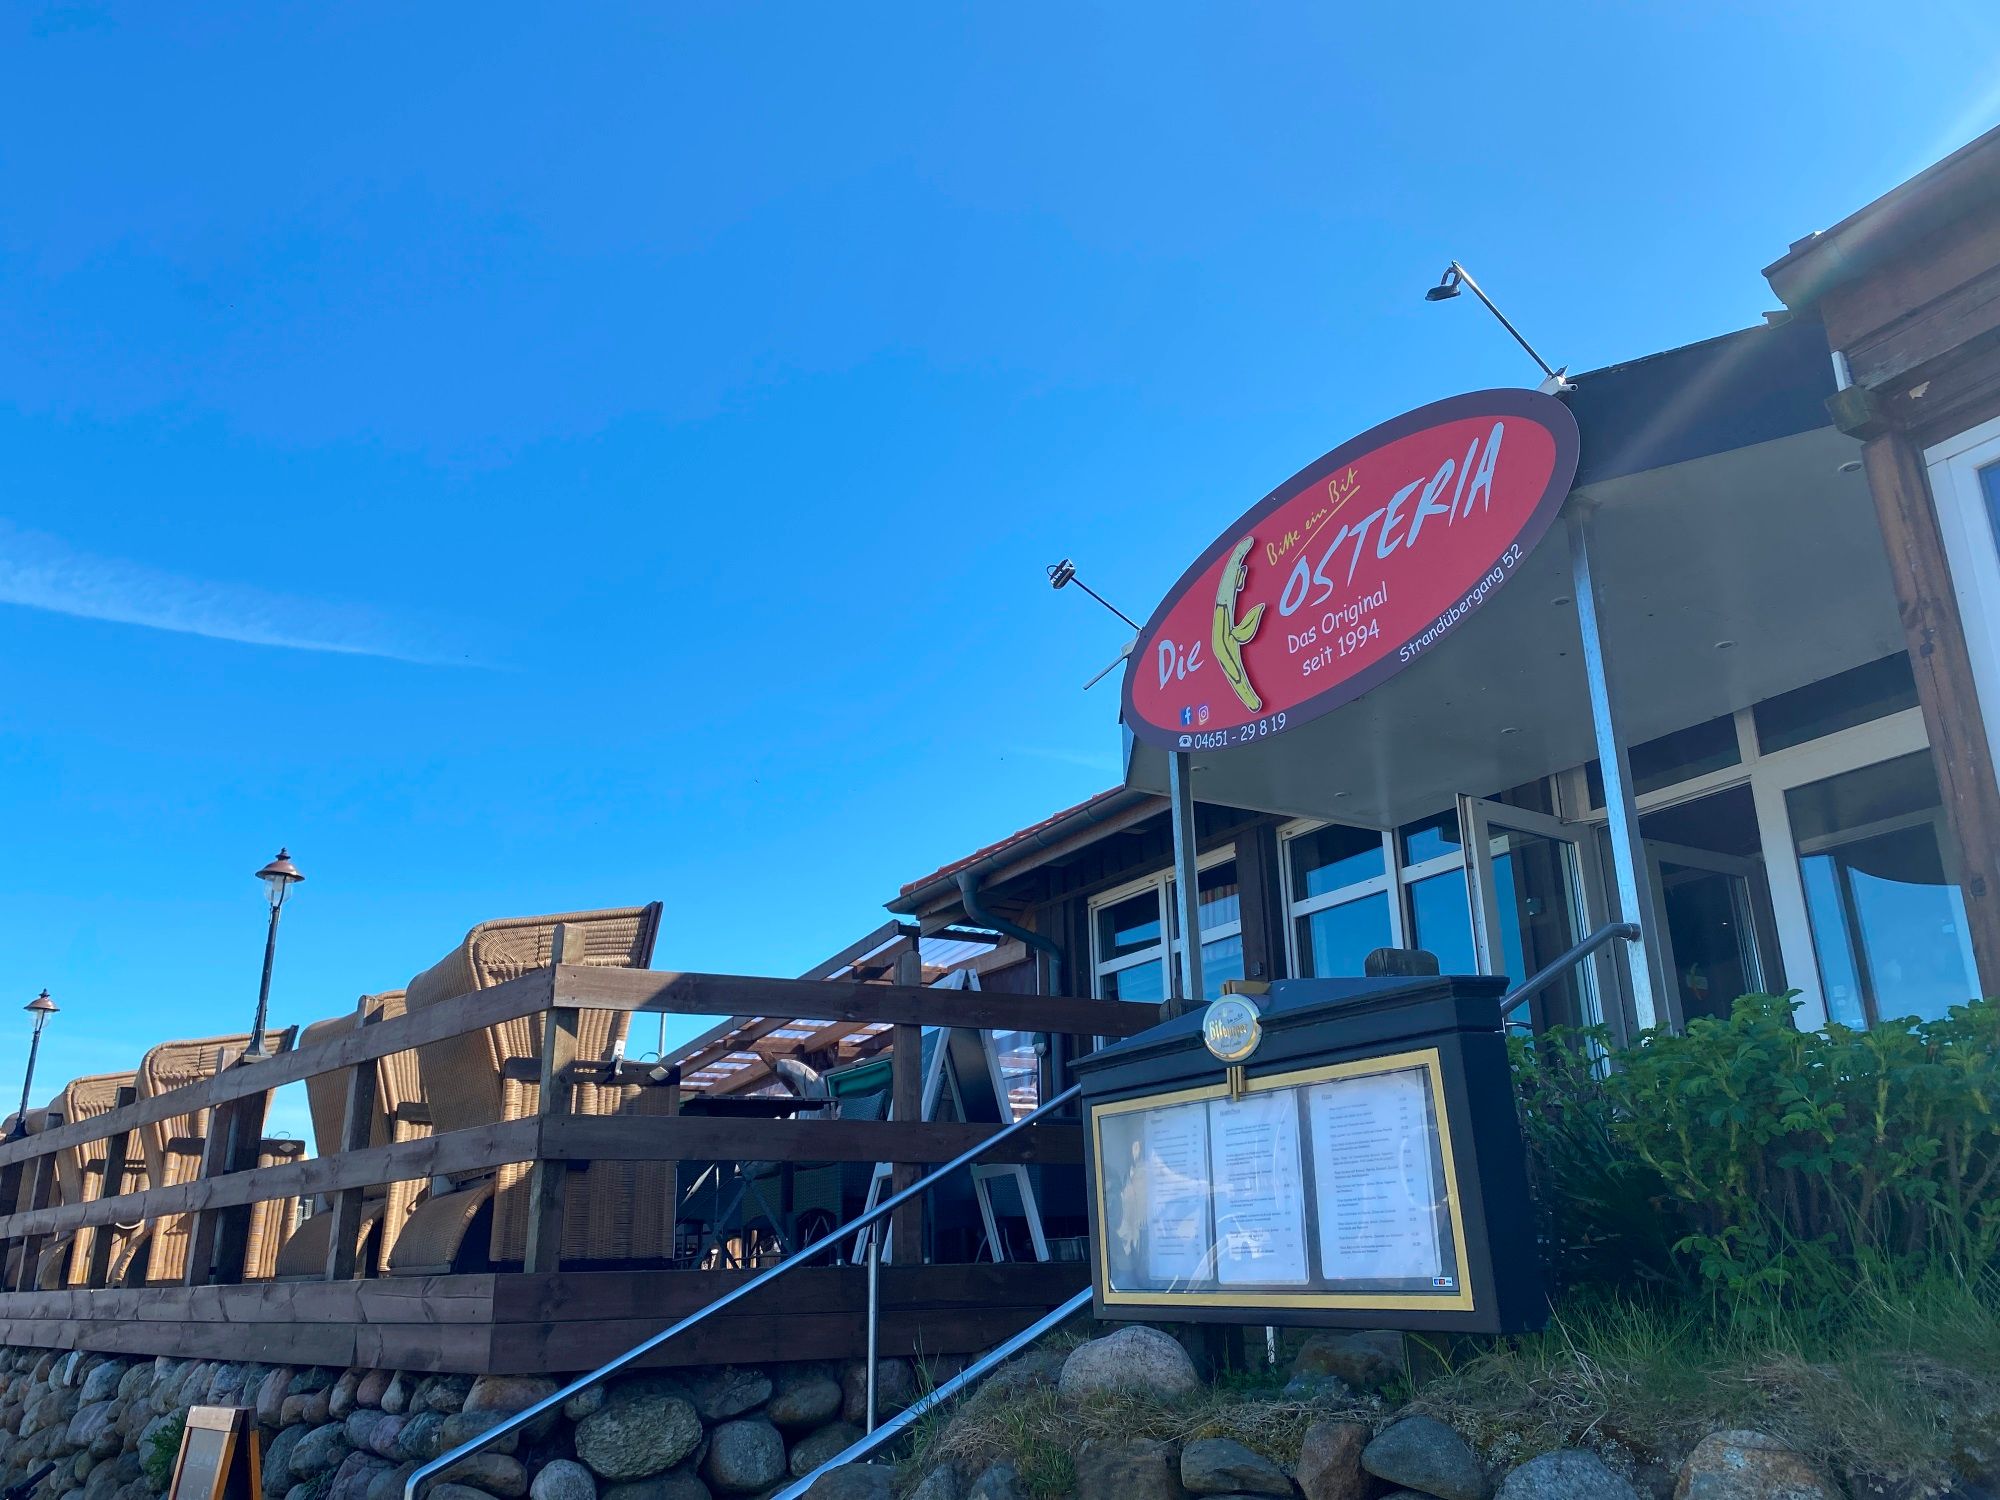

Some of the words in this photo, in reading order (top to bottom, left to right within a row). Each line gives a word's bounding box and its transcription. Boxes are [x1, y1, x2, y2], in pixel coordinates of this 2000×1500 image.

[1266, 530, 1301, 566] Bitte
[1305, 508, 1328, 530] ein
[1328, 467, 1358, 504] Bit
[1287, 626, 1317, 654] Das
[1321, 580, 1388, 634] Original
[1399, 566, 1505, 663] Strandübergang
[1501, 543, 1523, 569] 52
[1158, 639, 1204, 690] Die
[1302, 646, 1333, 676] seit
[1338, 618, 1380, 657] 1994
[1194, 730, 1228, 749] 04651
[1240, 723, 1256, 741] 29
[1259, 719, 1268, 736] 8
[1271, 712, 1286, 732] 19
